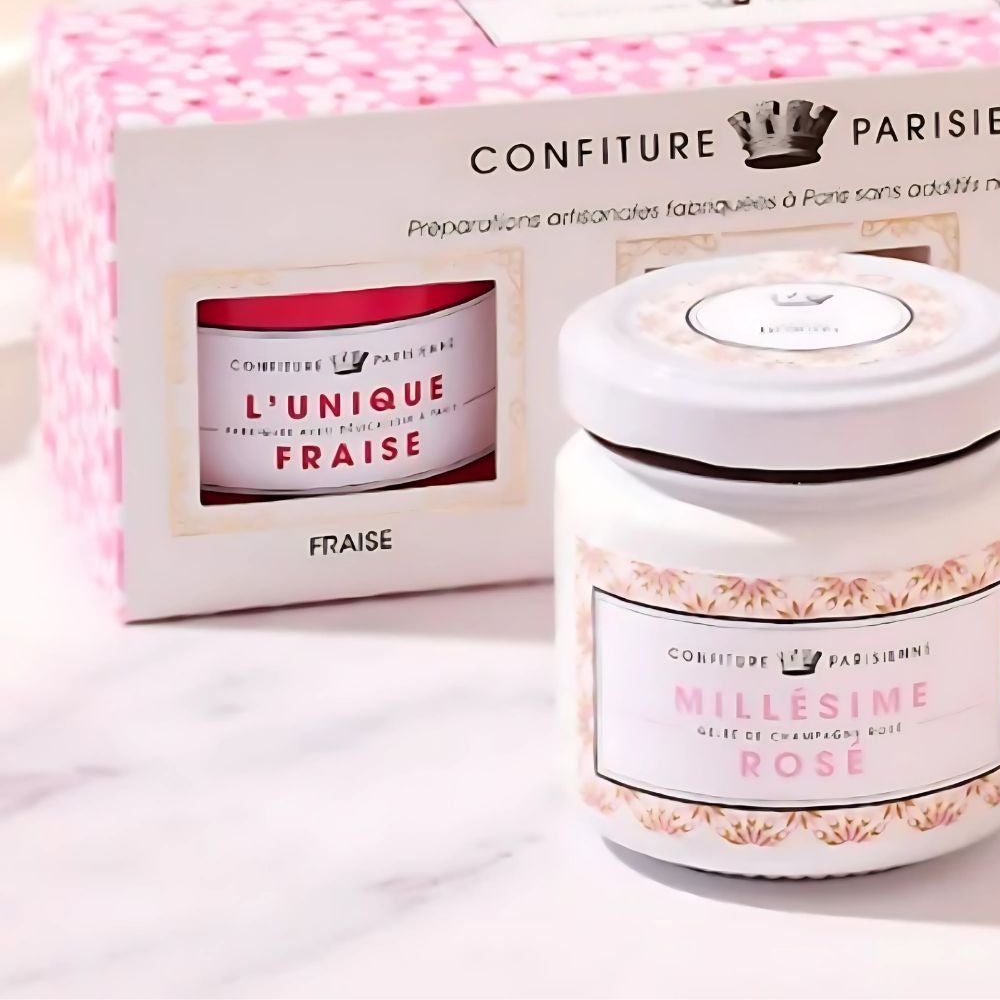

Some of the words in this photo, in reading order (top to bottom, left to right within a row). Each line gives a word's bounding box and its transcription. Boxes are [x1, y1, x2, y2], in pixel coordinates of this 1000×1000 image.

[470, 129, 715, 176] CONFITURE
[246, 374, 444, 420] L'UNIQUE
[276, 431, 421, 470] FRAISE
[309, 528, 393, 557] FRAISE
[674, 682, 927, 721] MILLÉSIME
[743, 740, 865, 777] ROSÉ
